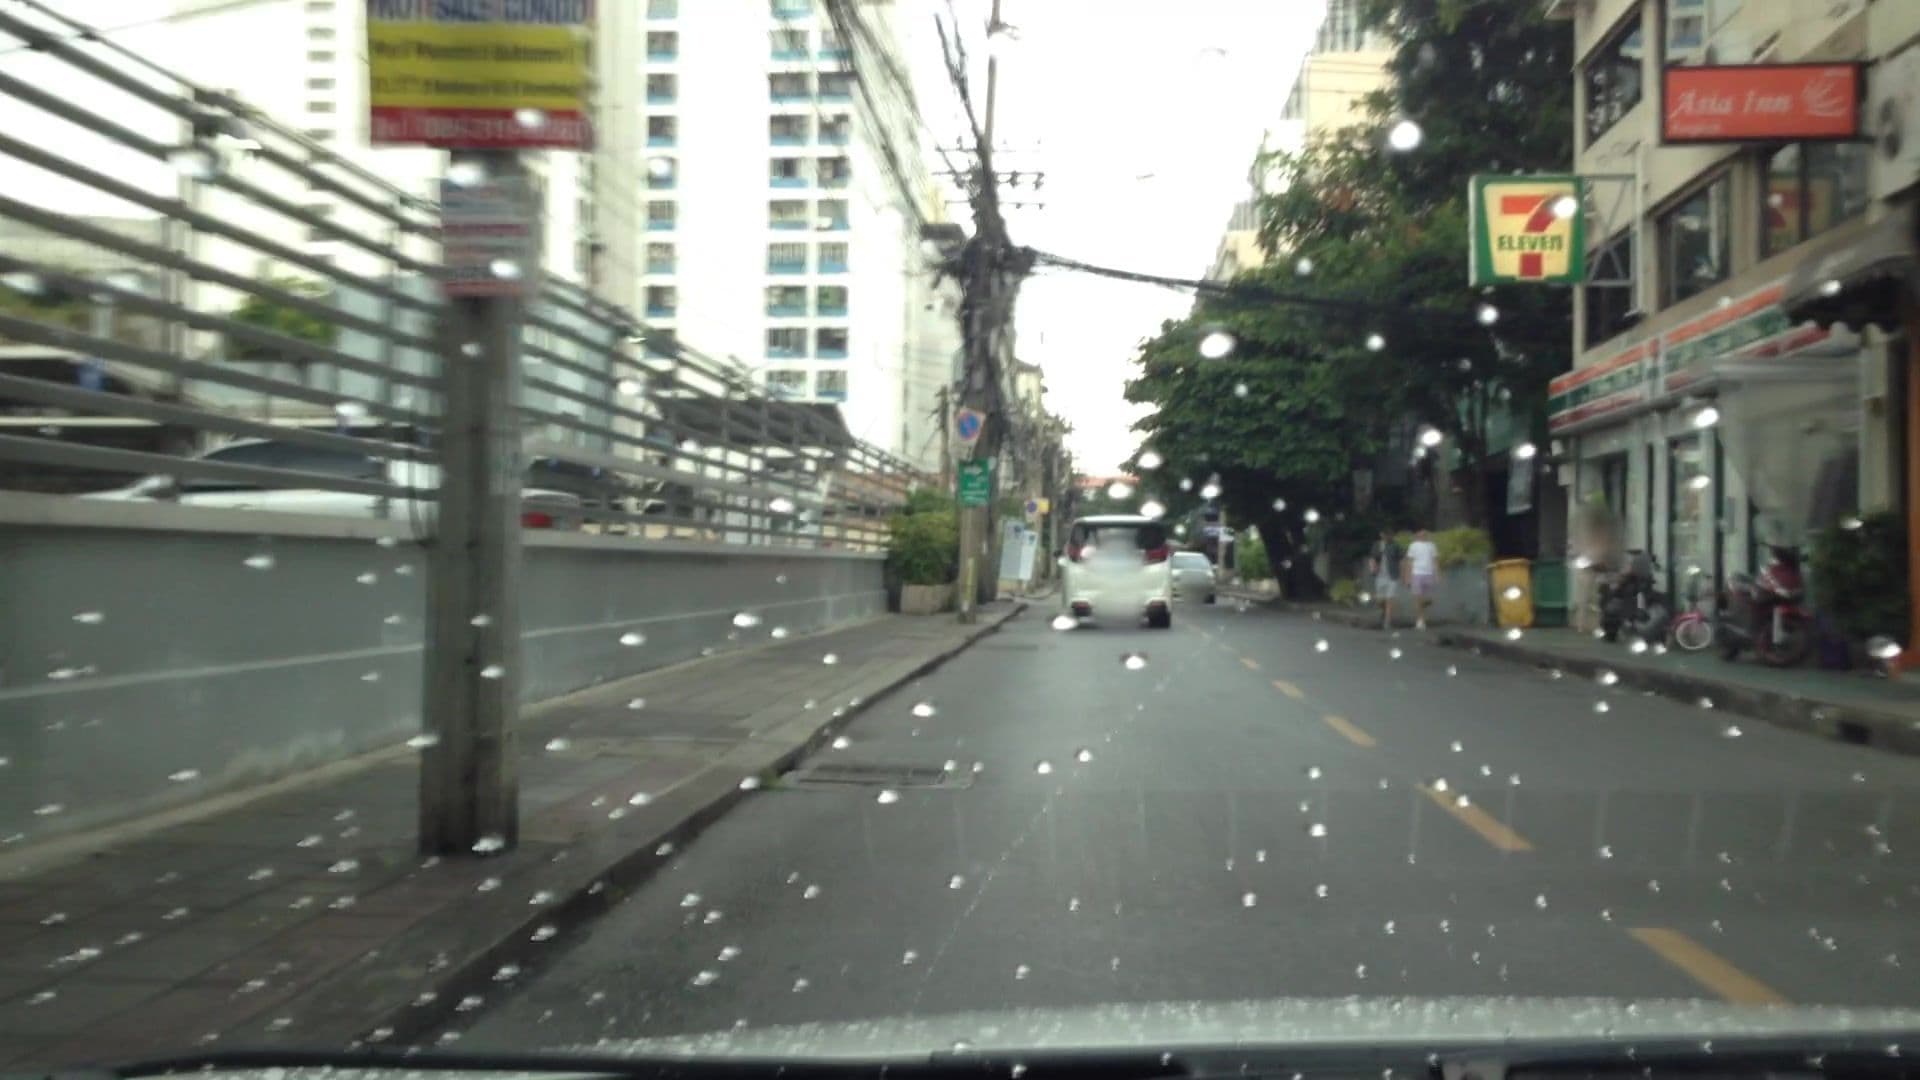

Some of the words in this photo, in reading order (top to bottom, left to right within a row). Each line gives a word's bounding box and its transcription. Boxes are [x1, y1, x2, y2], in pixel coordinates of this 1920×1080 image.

[1668, 88, 1733, 119] Asia
[1742, 90, 1794, 113] Inn
[1501, 193, 1573, 277] 7
